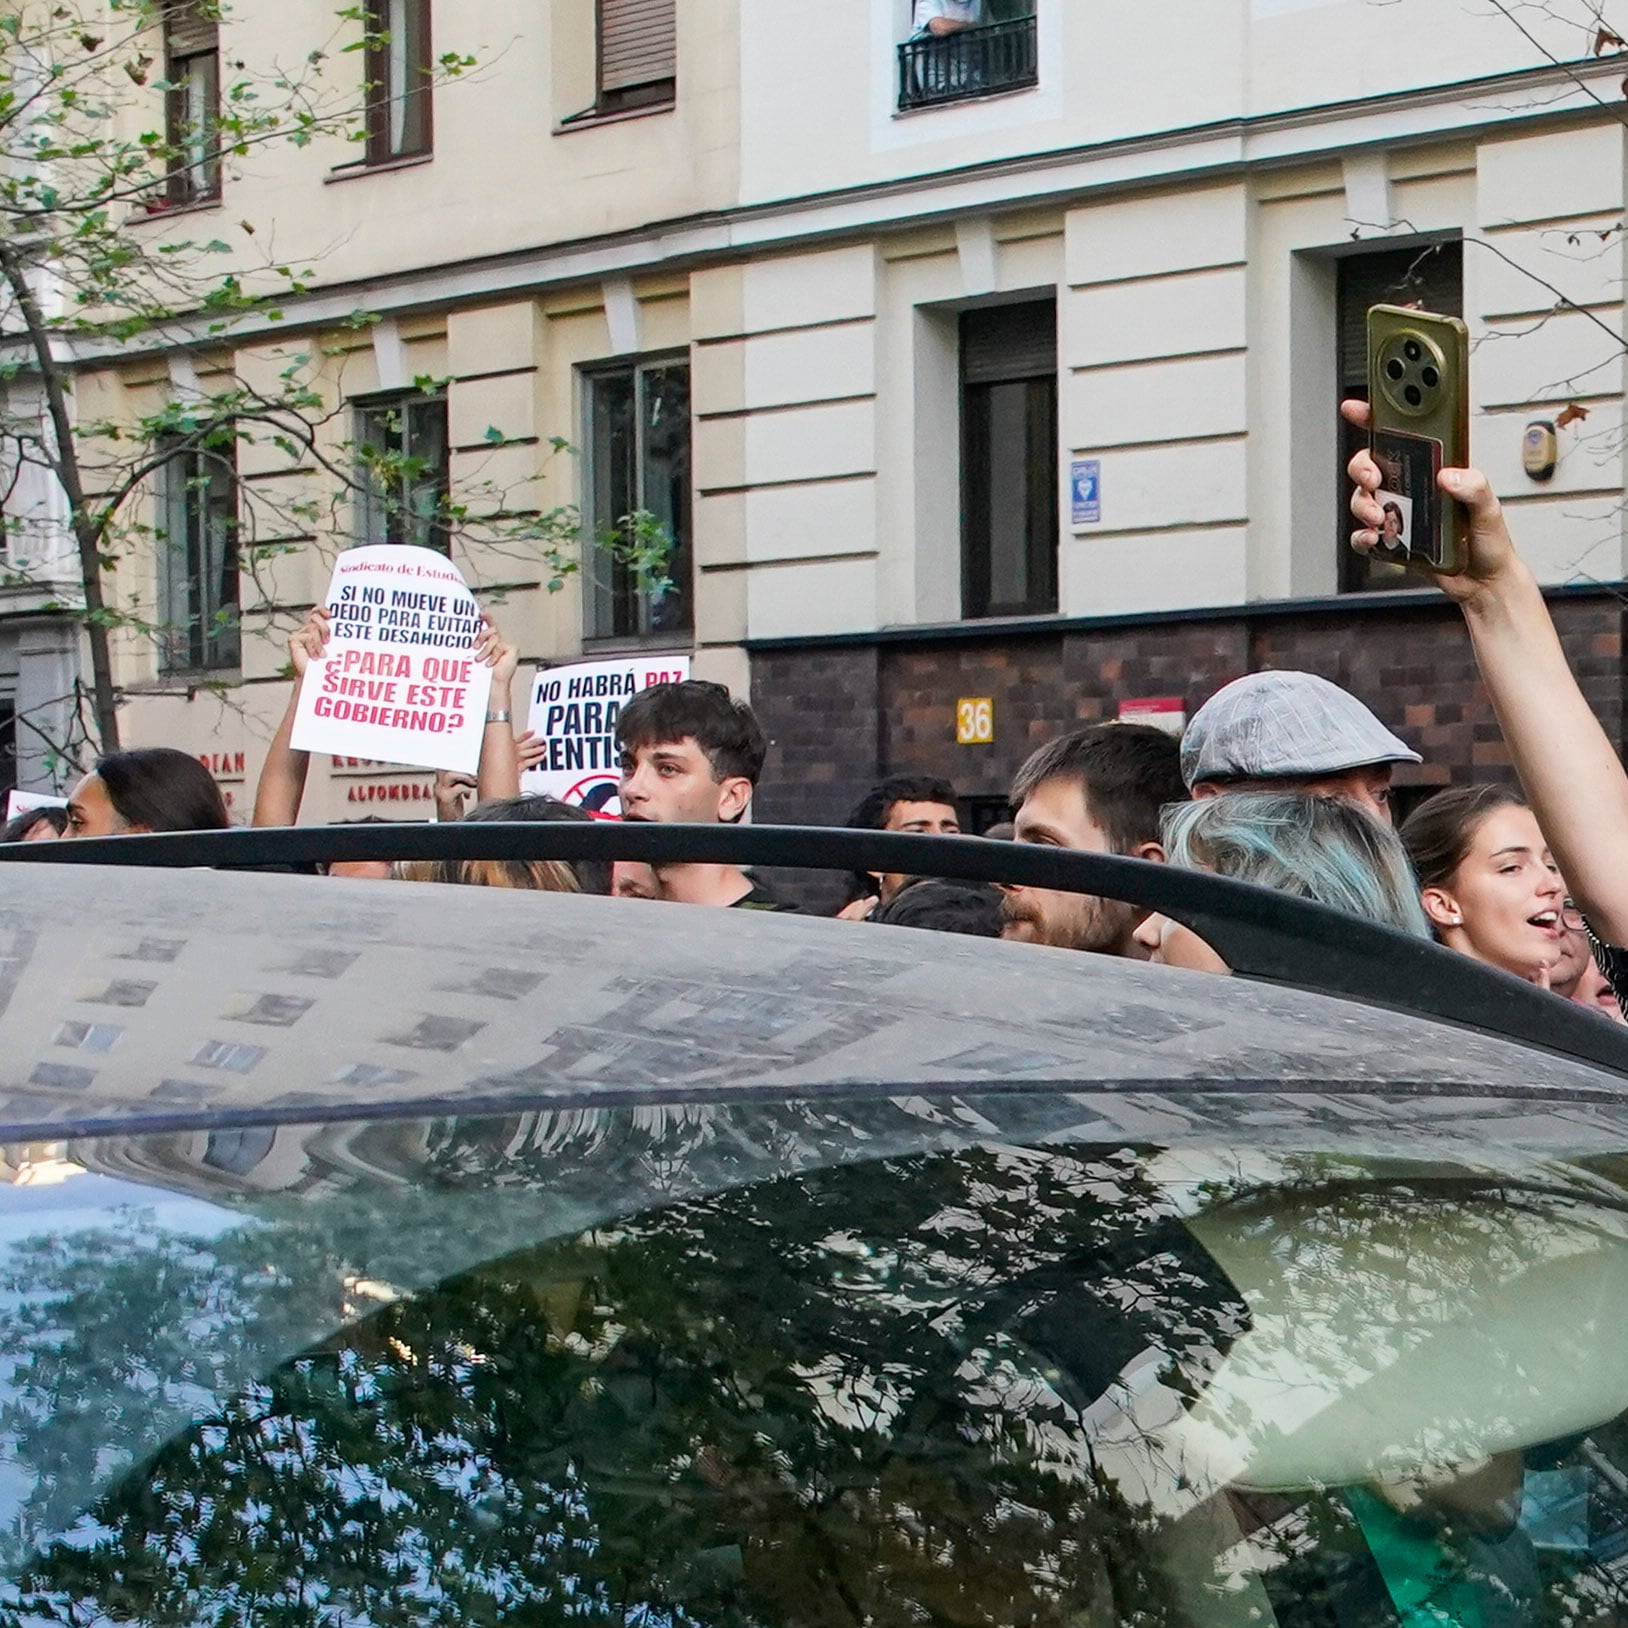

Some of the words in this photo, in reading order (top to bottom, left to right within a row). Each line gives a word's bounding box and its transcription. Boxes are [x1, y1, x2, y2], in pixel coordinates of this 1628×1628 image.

[397, 563, 414, 575] de
[340, 585, 357, 602] SI
[362, 587, 385, 605] NO
[392, 590, 448, 613] MUEVE
[453, 598, 476, 617] UN
[334, 622, 372, 640] ESTE
[378, 627, 473, 650] DESAHUCIO
[378, 607, 421, 629] PARA
[427, 615, 485, 635] EVITAR
[325, 649, 412, 678] ¿PARA
[422, 656, 474, 684] QUÉ
[322, 673, 397, 703] SIRVE
[406, 684, 467, 709] ESTE
[536, 680, 562, 704] NO
[568, 668, 637, 700] HABRÁ
[314, 696, 465, 734] GOBIERNO?
[960, 702, 992, 740] 36
